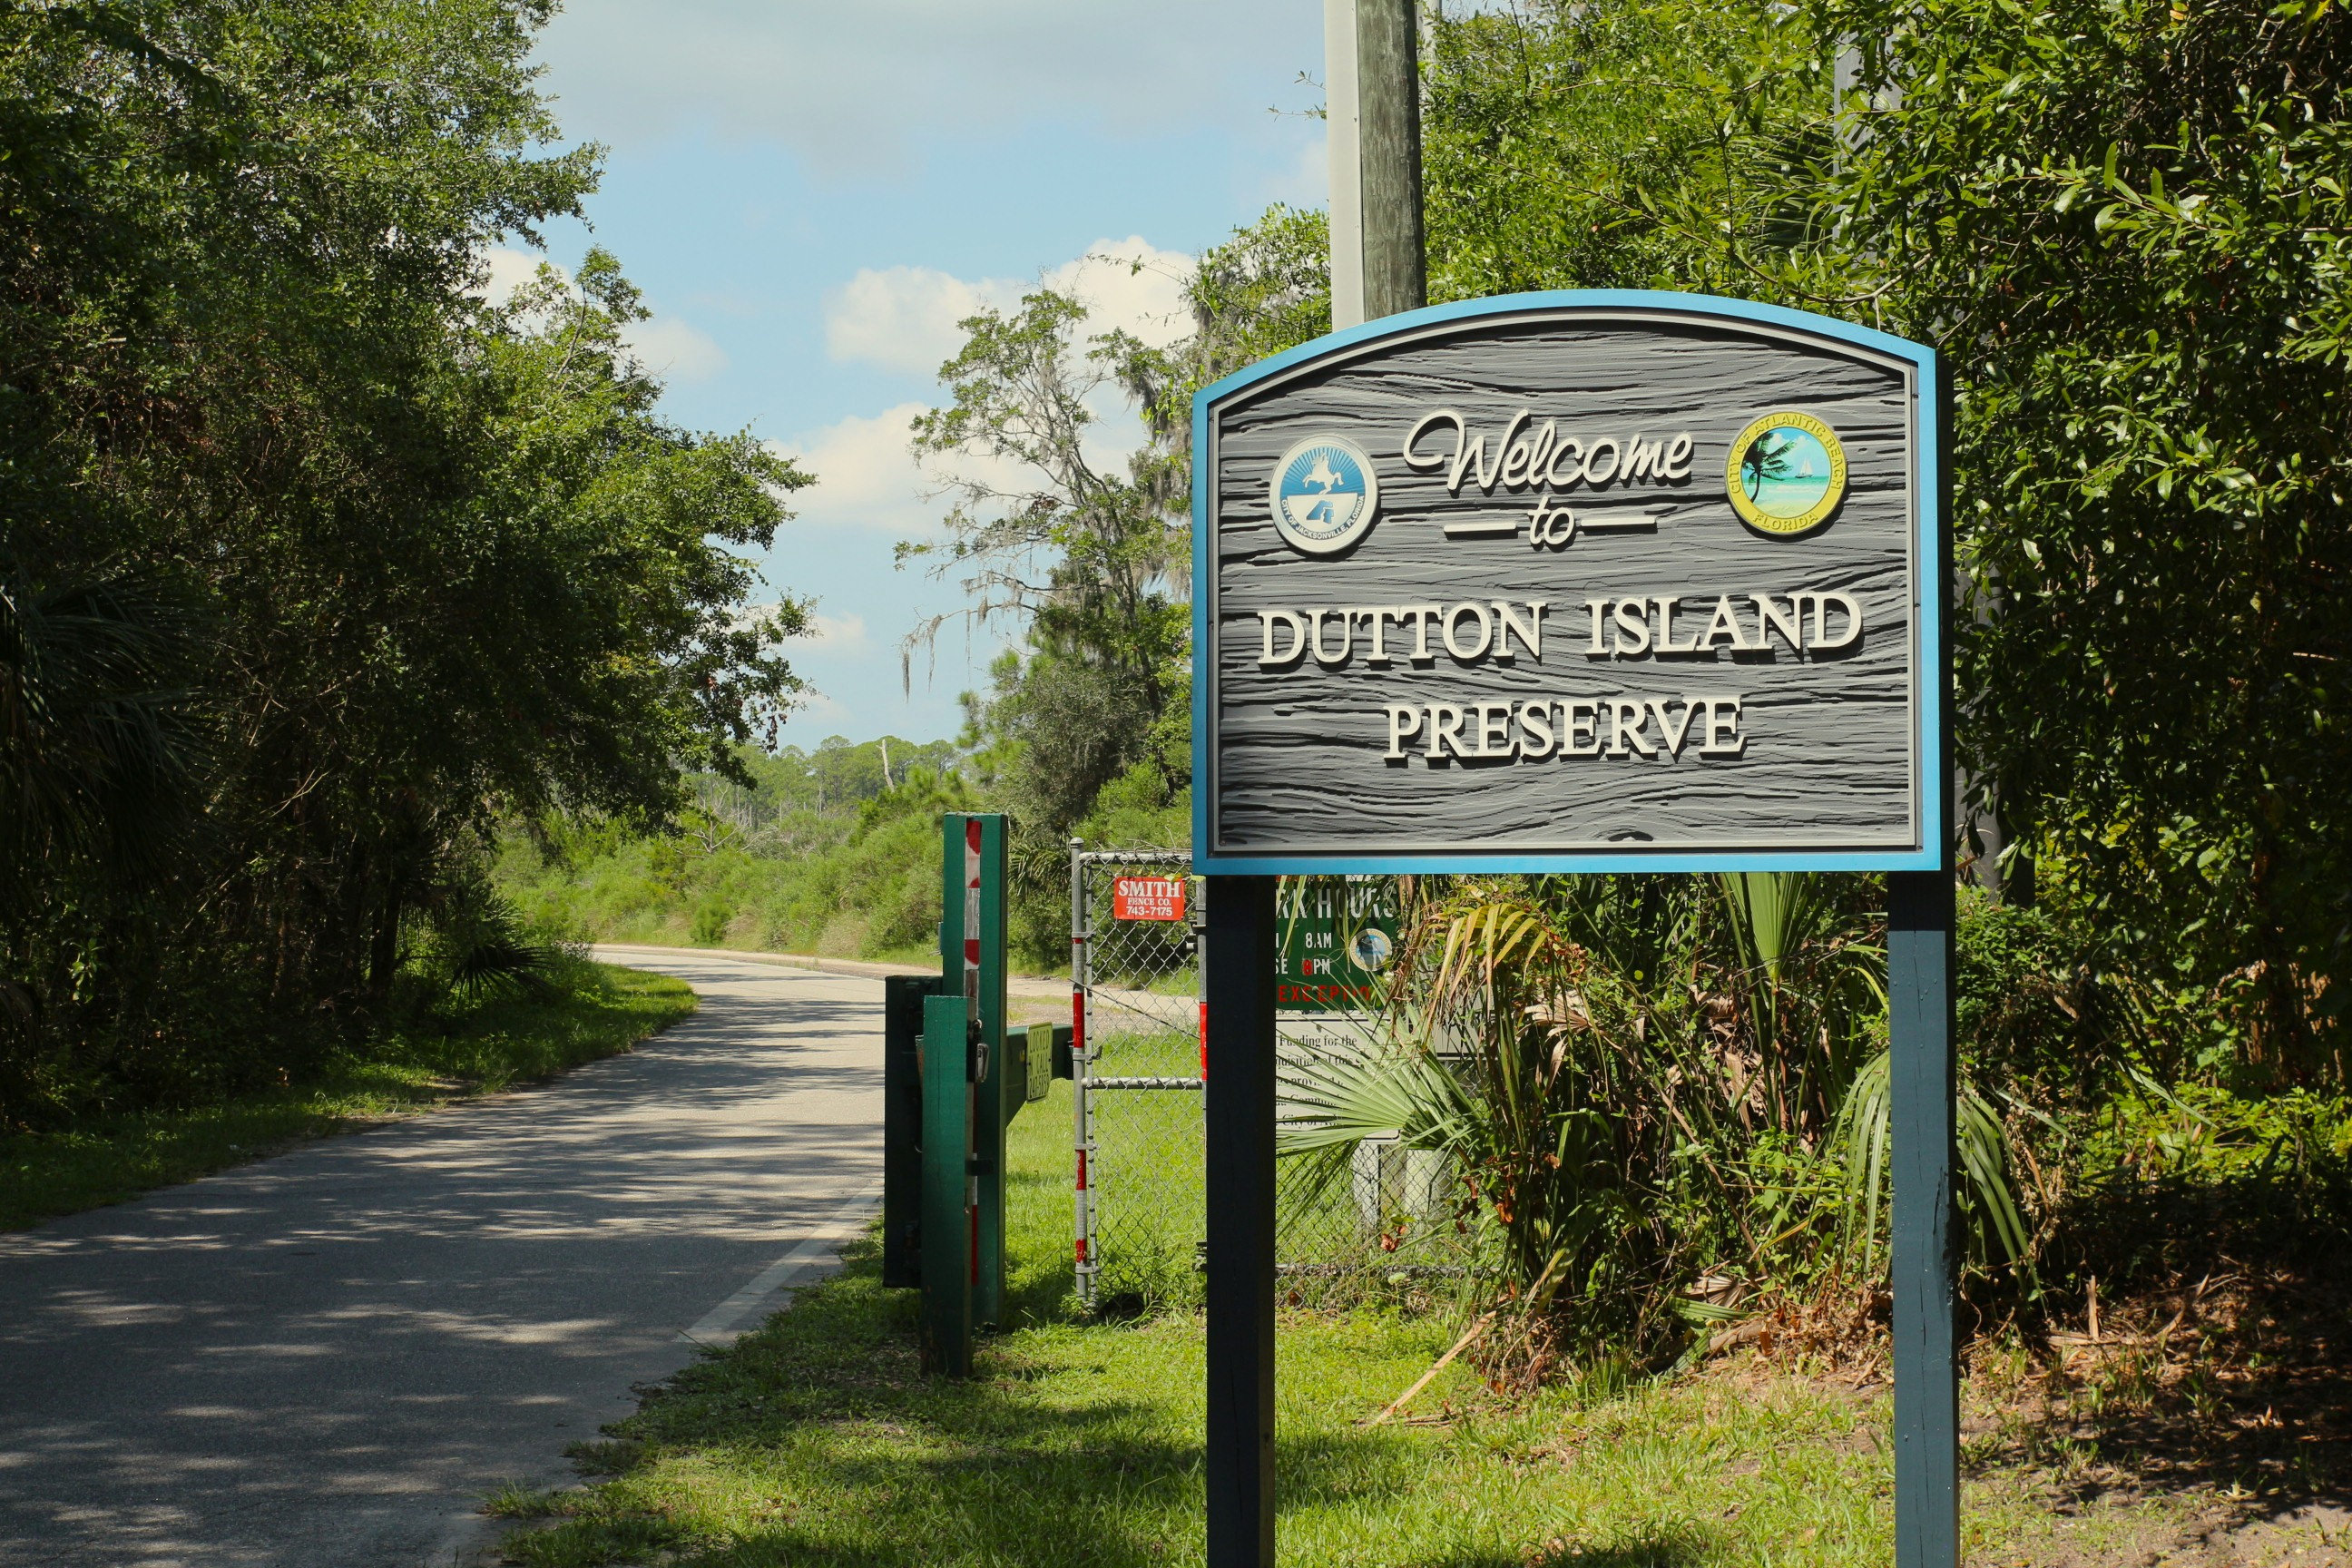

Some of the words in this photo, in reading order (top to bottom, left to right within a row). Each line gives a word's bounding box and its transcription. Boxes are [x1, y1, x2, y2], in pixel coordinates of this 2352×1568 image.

[1404, 409, 1692, 490] Welcome
[1729, 456, 1741, 494] CITY
[1737, 434, 1750, 453] OF
[1753, 415, 1827, 436] ATLANTIC
[1826, 436, 1844, 490] BEACH
[1280, 499, 1291, 516] CITY
[1288, 515, 1297, 527] OF
[1295, 524, 1349, 540] JACKSONVILLE,
[1348, 495, 1365, 526] FLORIDA
[1528, 495, 1575, 544] to
[1753, 513, 1818, 531] FLORIDA
[1257, 602, 1546, 664] DUTTON
[1585, 593, 1862, 655] ISLAND
[1383, 697, 1746, 759] PRESERVE
[1118, 880, 1181, 897] SMITH
[1127, 897, 1155, 906] FENCE
[1157, 897, 1171, 906] CO.
[1126, 906, 1173, 916] 743-7175
[1305, 932, 1332, 949] 8AM
[1324, 1034, 1338, 1046] for
[1341, 1034, 1357, 1046] the
